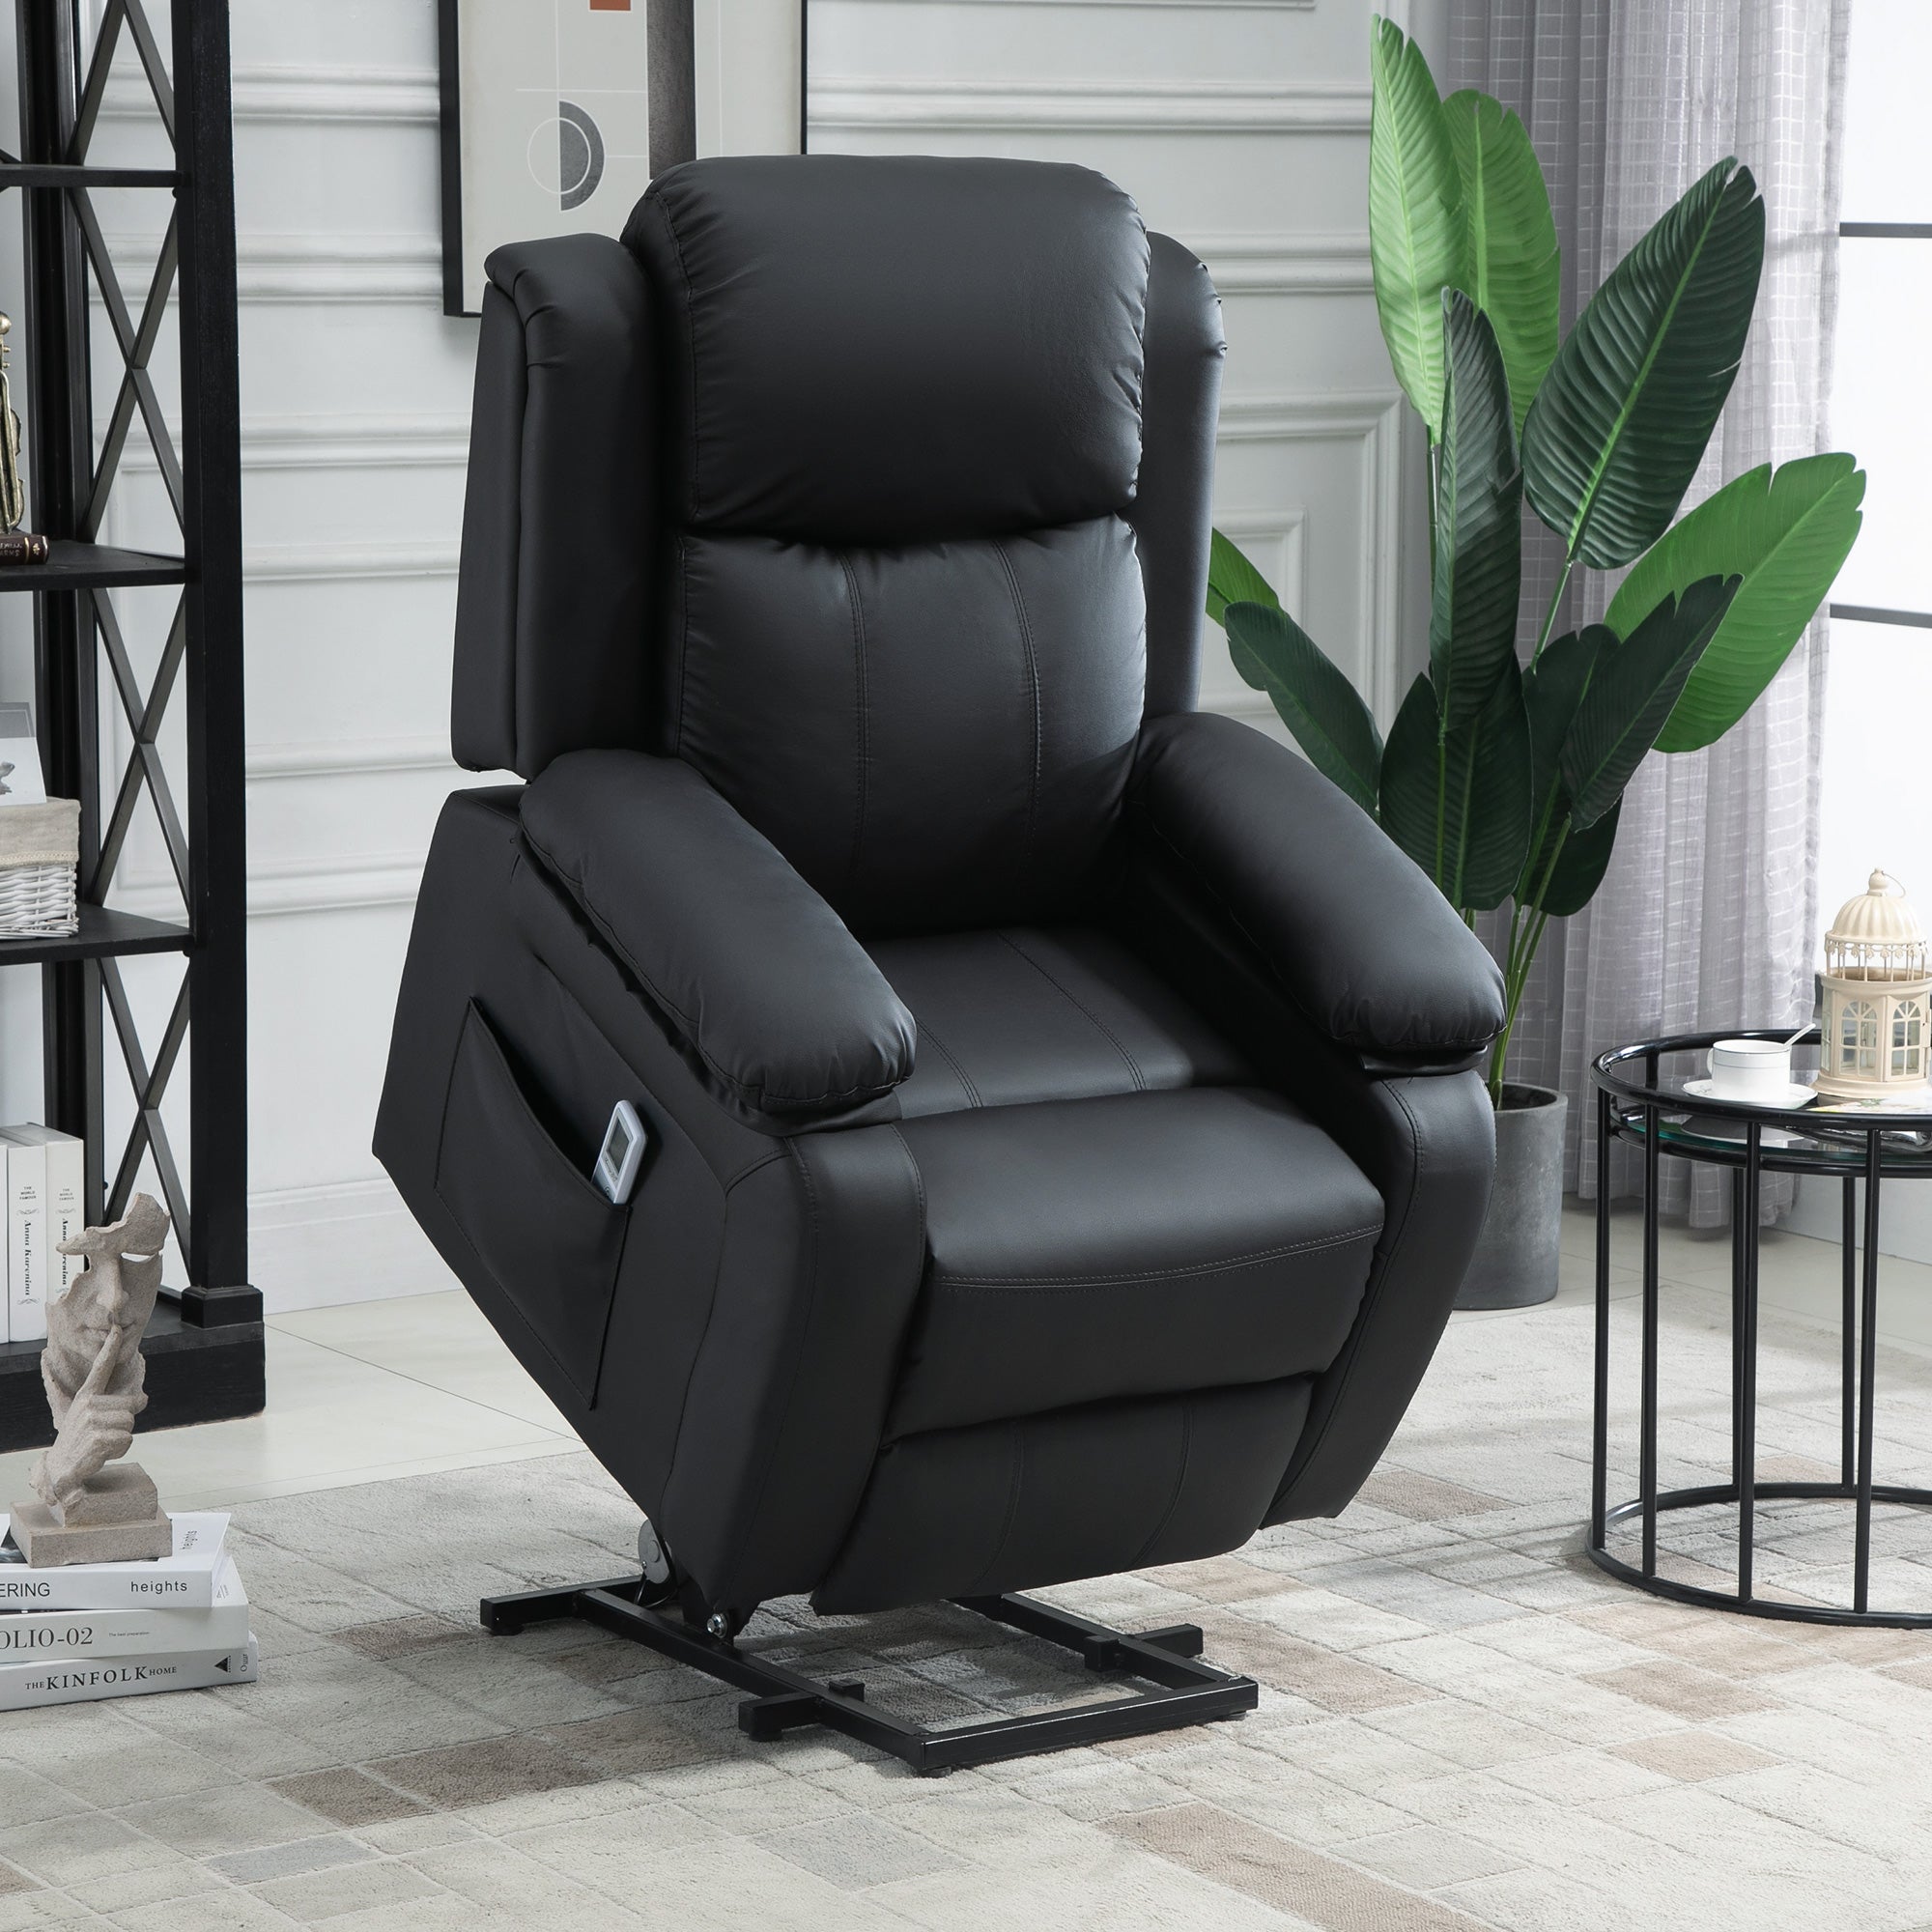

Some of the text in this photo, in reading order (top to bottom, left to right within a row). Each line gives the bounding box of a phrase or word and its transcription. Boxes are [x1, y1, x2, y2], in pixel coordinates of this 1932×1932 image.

[130, 1580, 187, 1595] heights
[46, 1666, 148, 1690] KINFOLK
[149, 1666, 178, 1676] HOME
